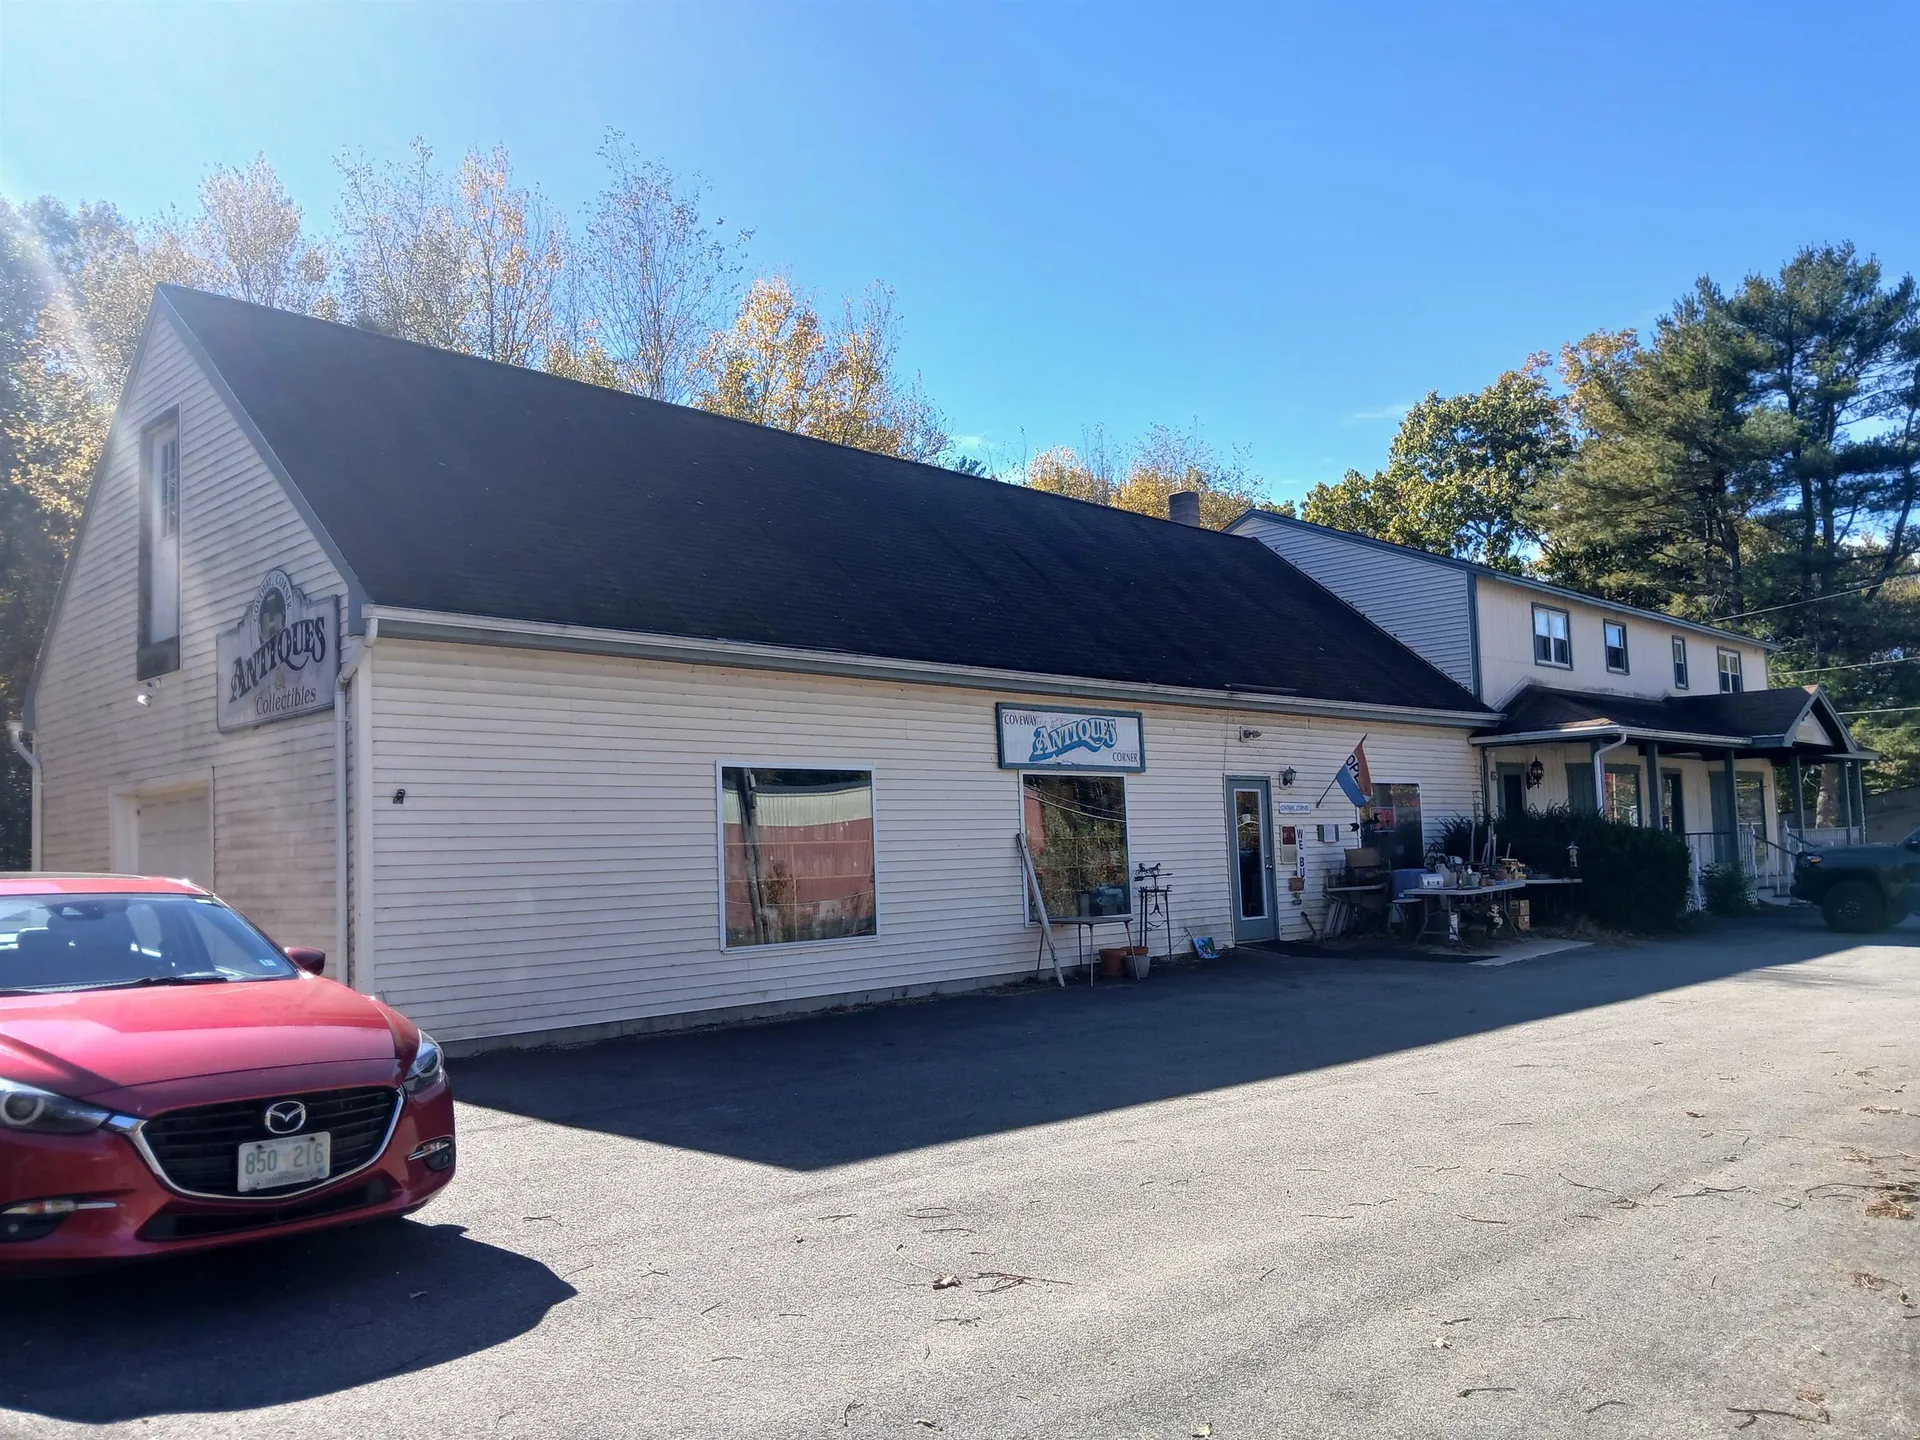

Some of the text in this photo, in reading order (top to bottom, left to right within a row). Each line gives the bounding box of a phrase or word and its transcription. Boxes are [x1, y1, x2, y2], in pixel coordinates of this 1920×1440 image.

[229, 616, 326, 704] ANTIQUES
[256, 687, 316, 715] Collectibles
[1004, 714, 1039, 726] COVEWAY
[1031, 717, 1117, 757] ANTIQUES
[1113, 752, 1138, 763] CORNER
[1297, 829, 1304, 850] WE
[245, 1143, 324, 1175] 850 216
